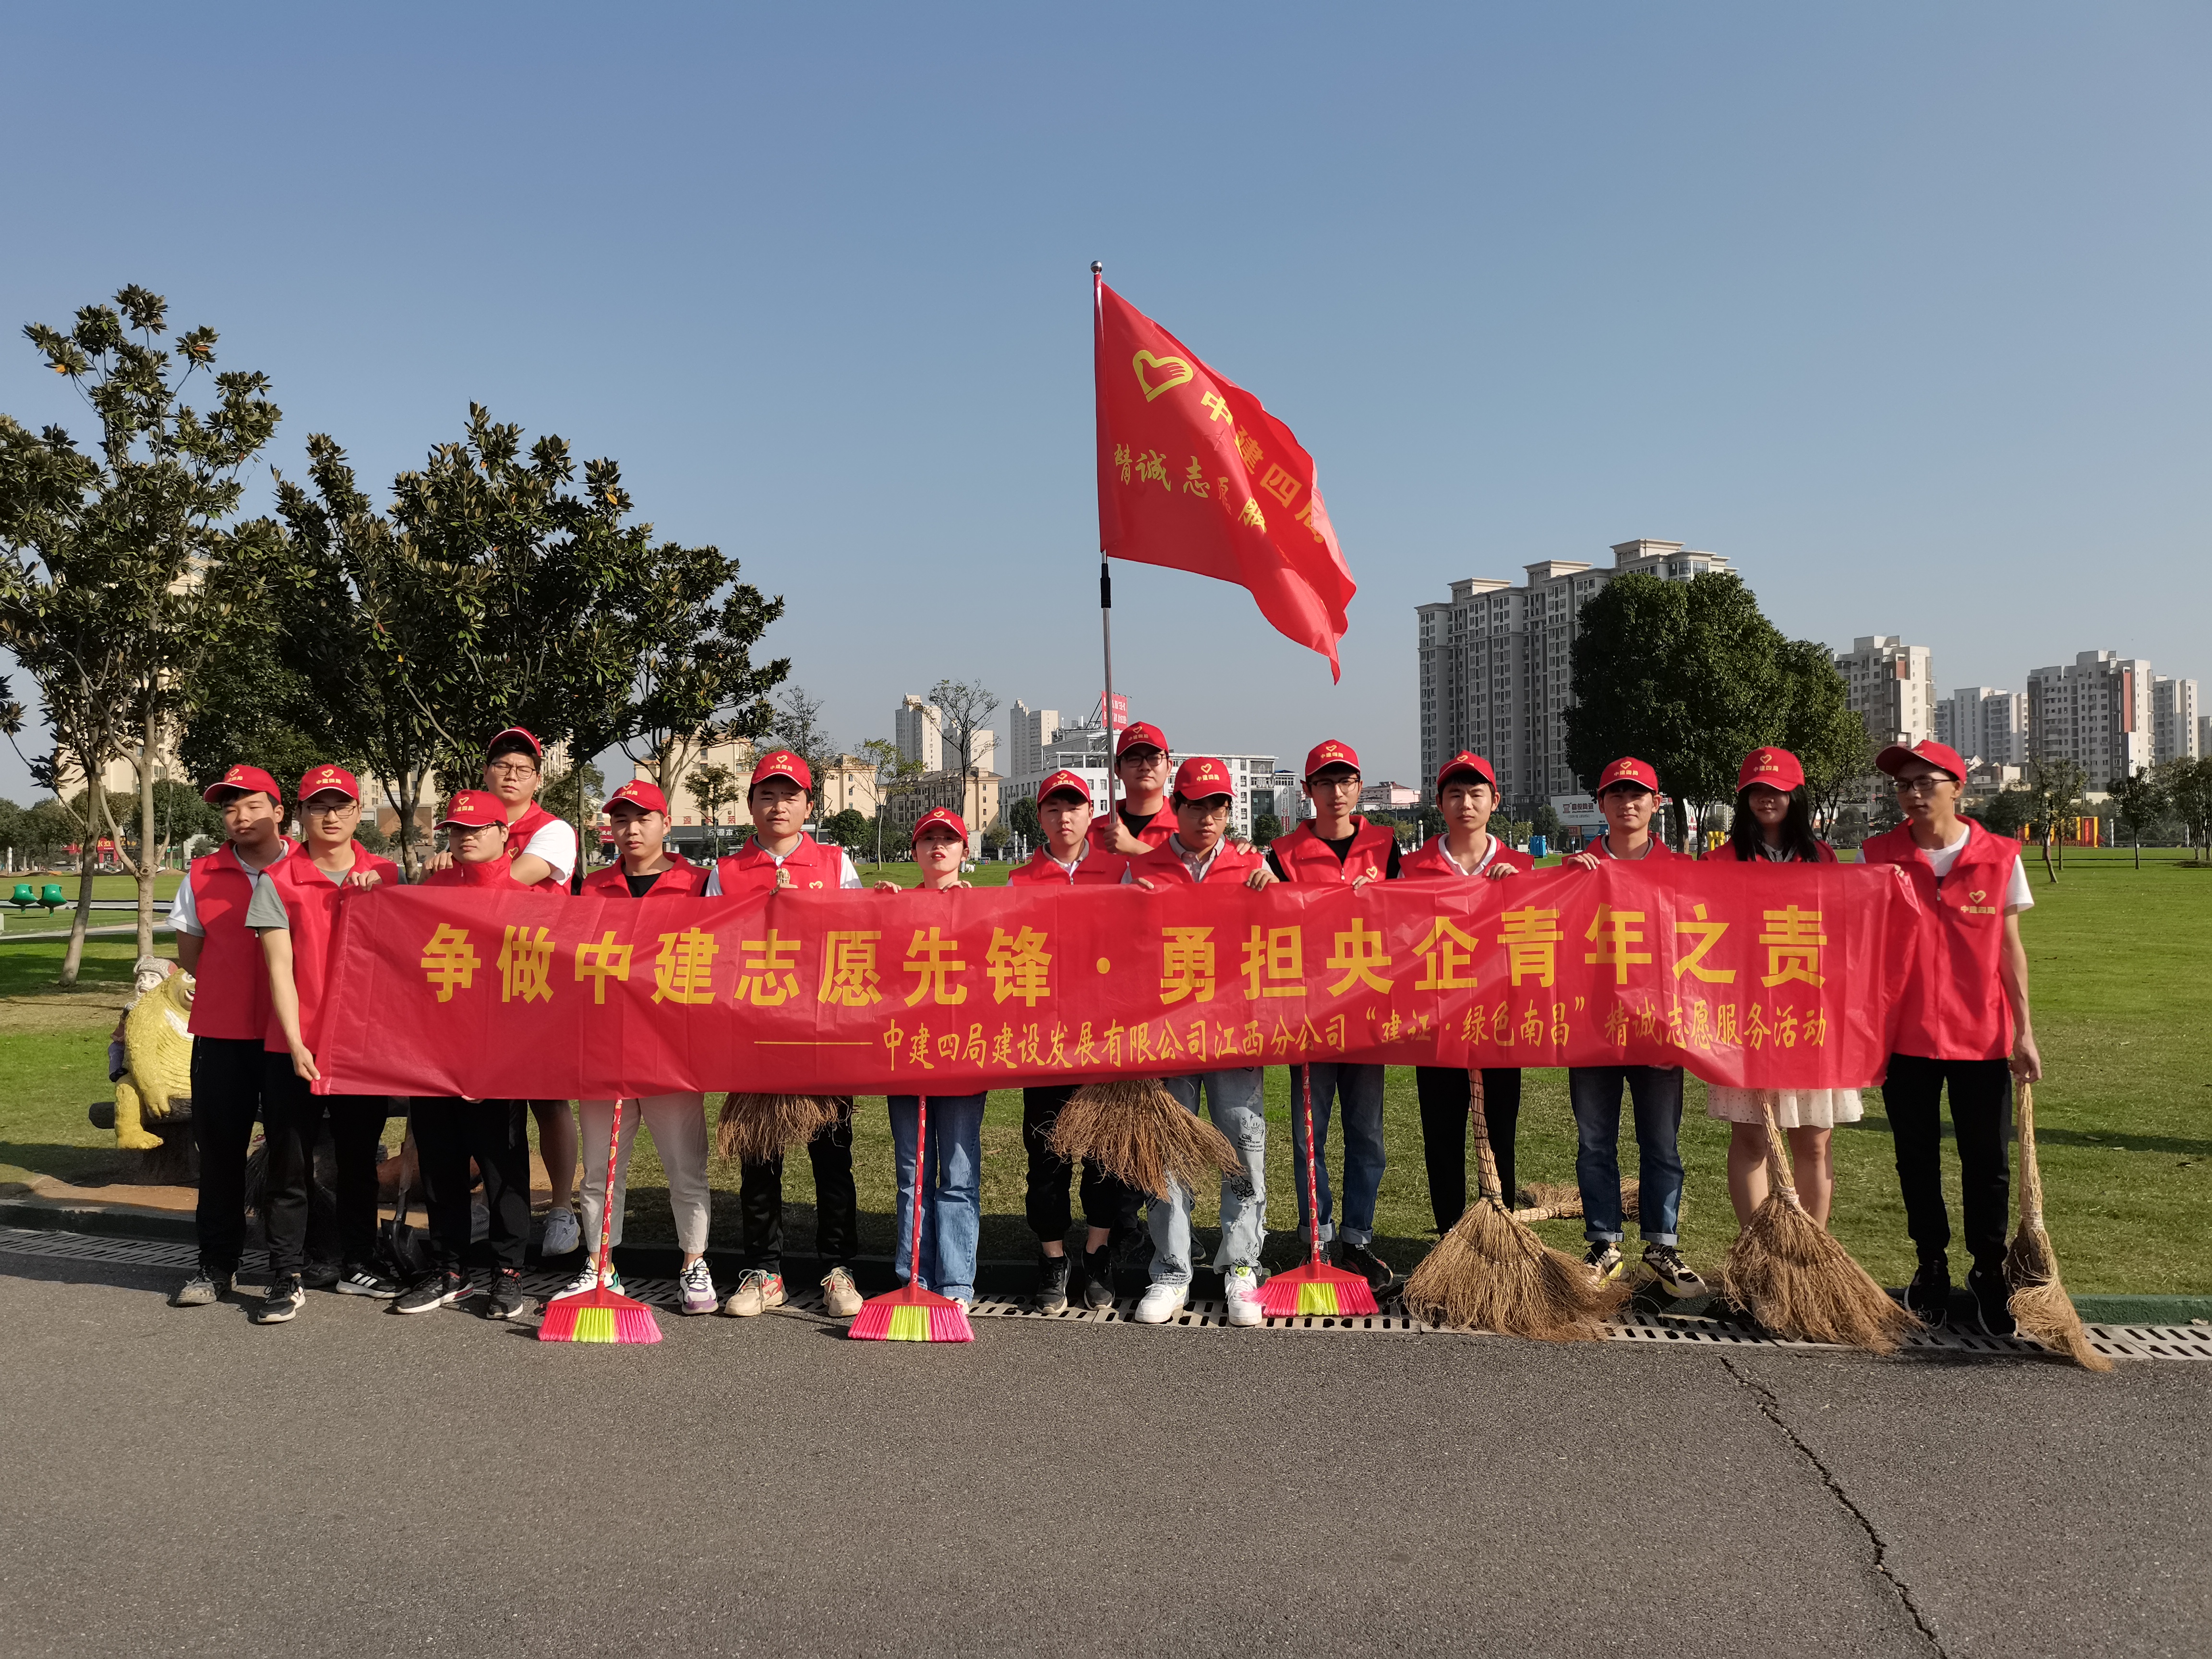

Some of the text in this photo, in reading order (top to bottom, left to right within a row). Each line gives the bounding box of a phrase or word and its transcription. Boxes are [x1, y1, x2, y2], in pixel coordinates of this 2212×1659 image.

[769, 764, 793, 772] 中建四局
[1196, 774, 1220, 782] 中建四局
[1960, 905, 1996, 915] 中建四局
[421, 903, 1827, 1007] 争做中建志愿先锋·勇担央企青年之责
